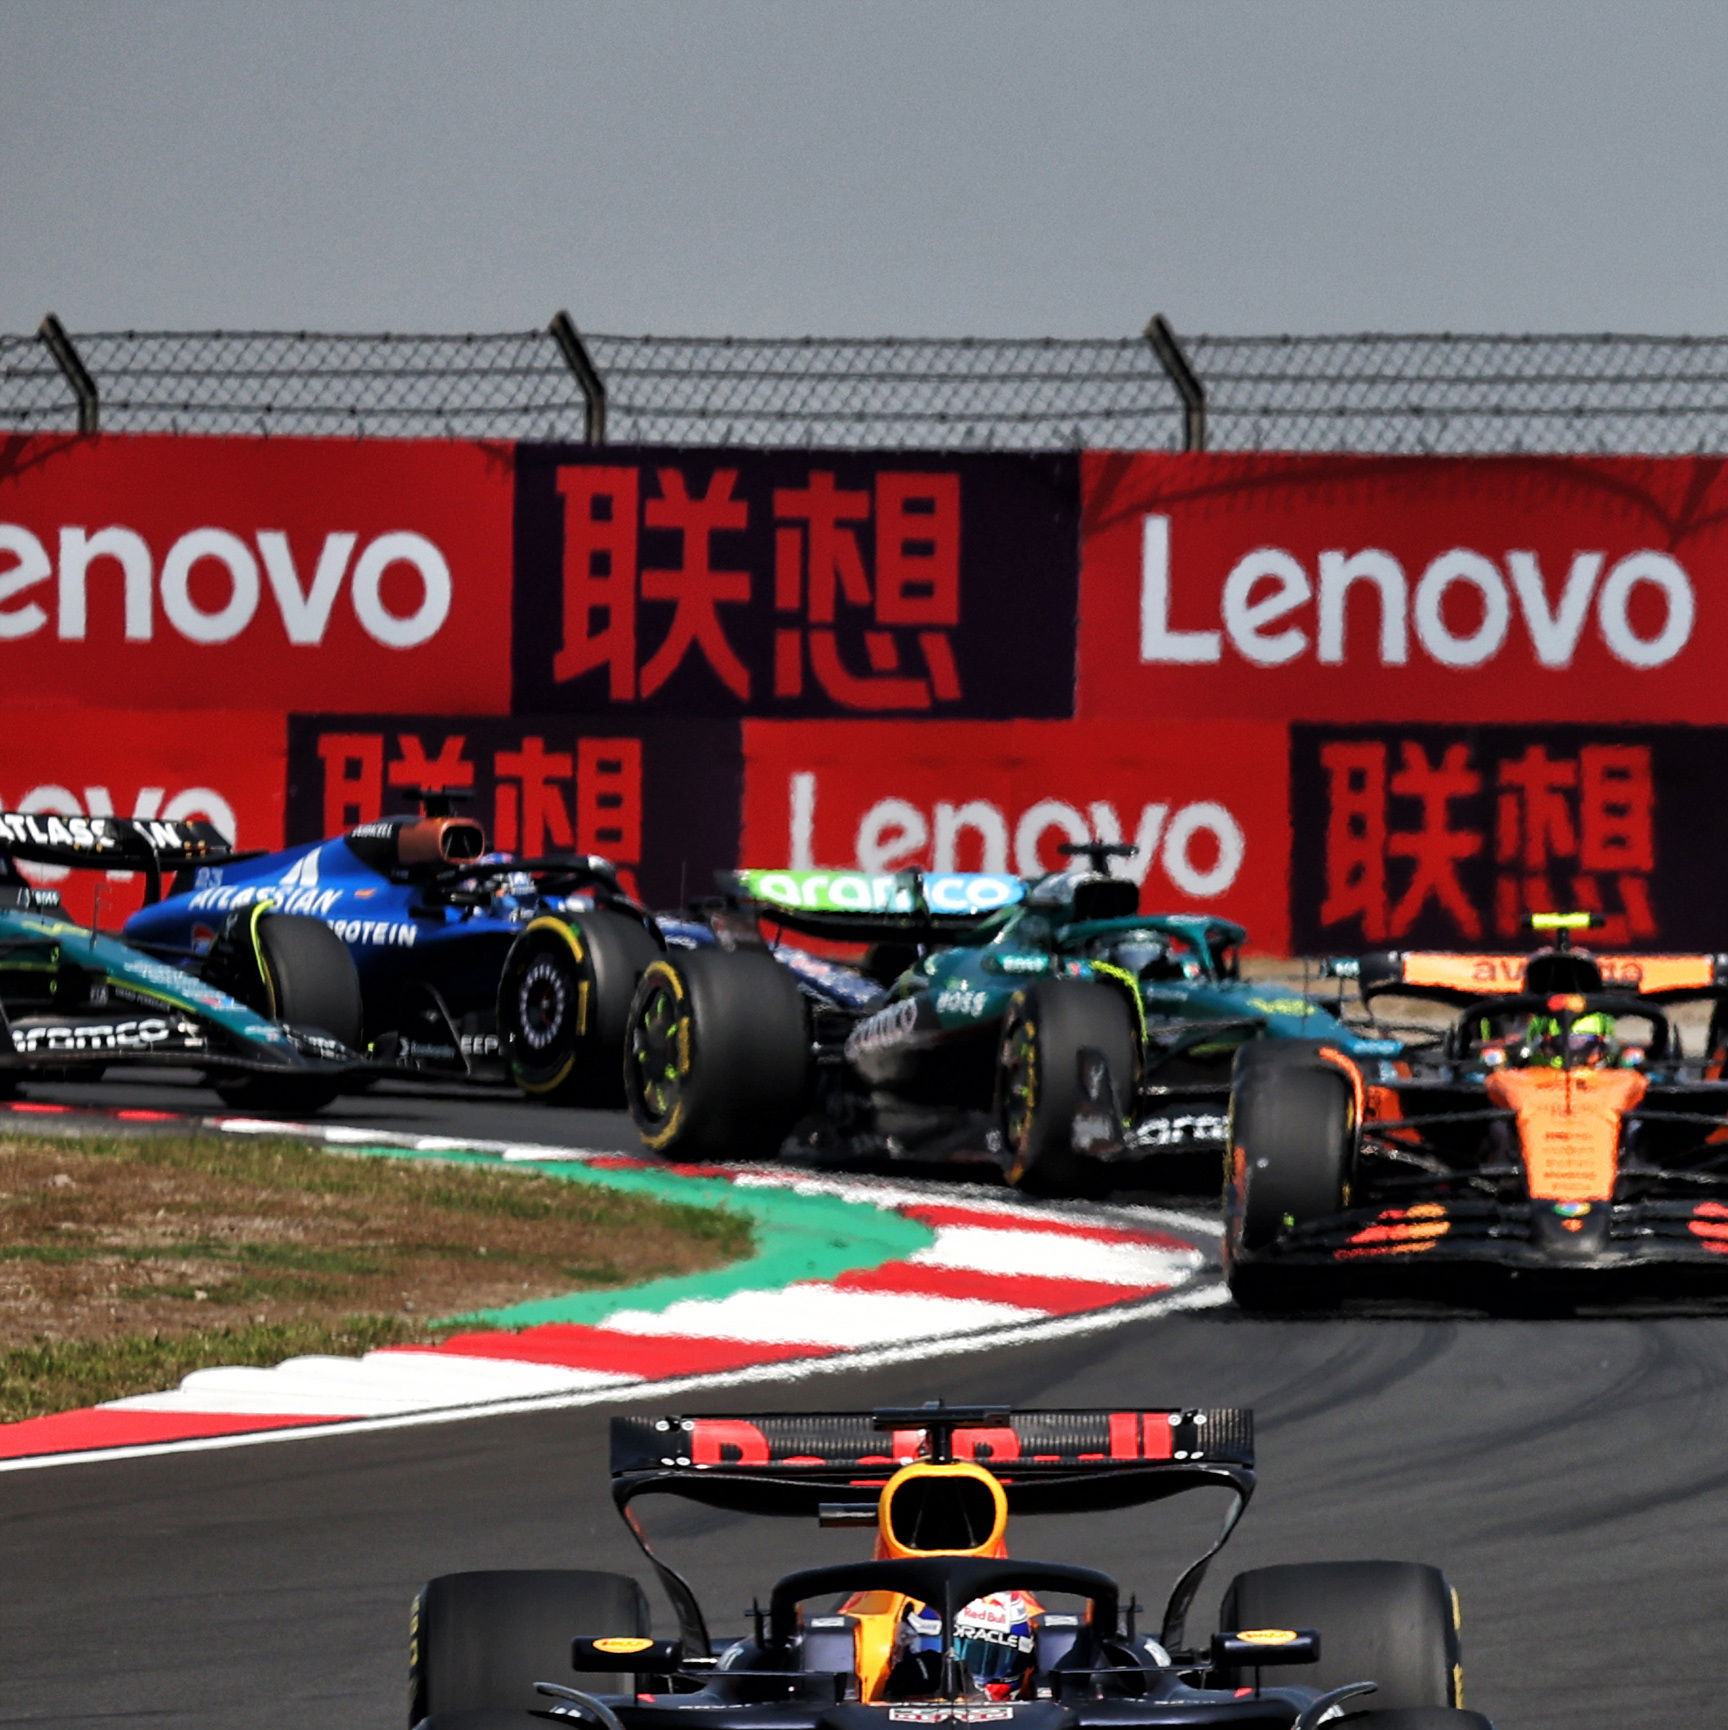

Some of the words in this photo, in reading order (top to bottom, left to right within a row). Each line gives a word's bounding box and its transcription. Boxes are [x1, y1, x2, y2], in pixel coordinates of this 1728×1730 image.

[0, 525, 452, 648] enovo
[555, 466, 960, 709] 联想
[1140, 514, 1695, 667] Lenovo
[788, 772, 1244, 898] Lenovo
[1320, 743, 1656, 945] 联想
[964, 1607, 985, 1620] Red
[987, 1611, 1006, 1625] Bull
